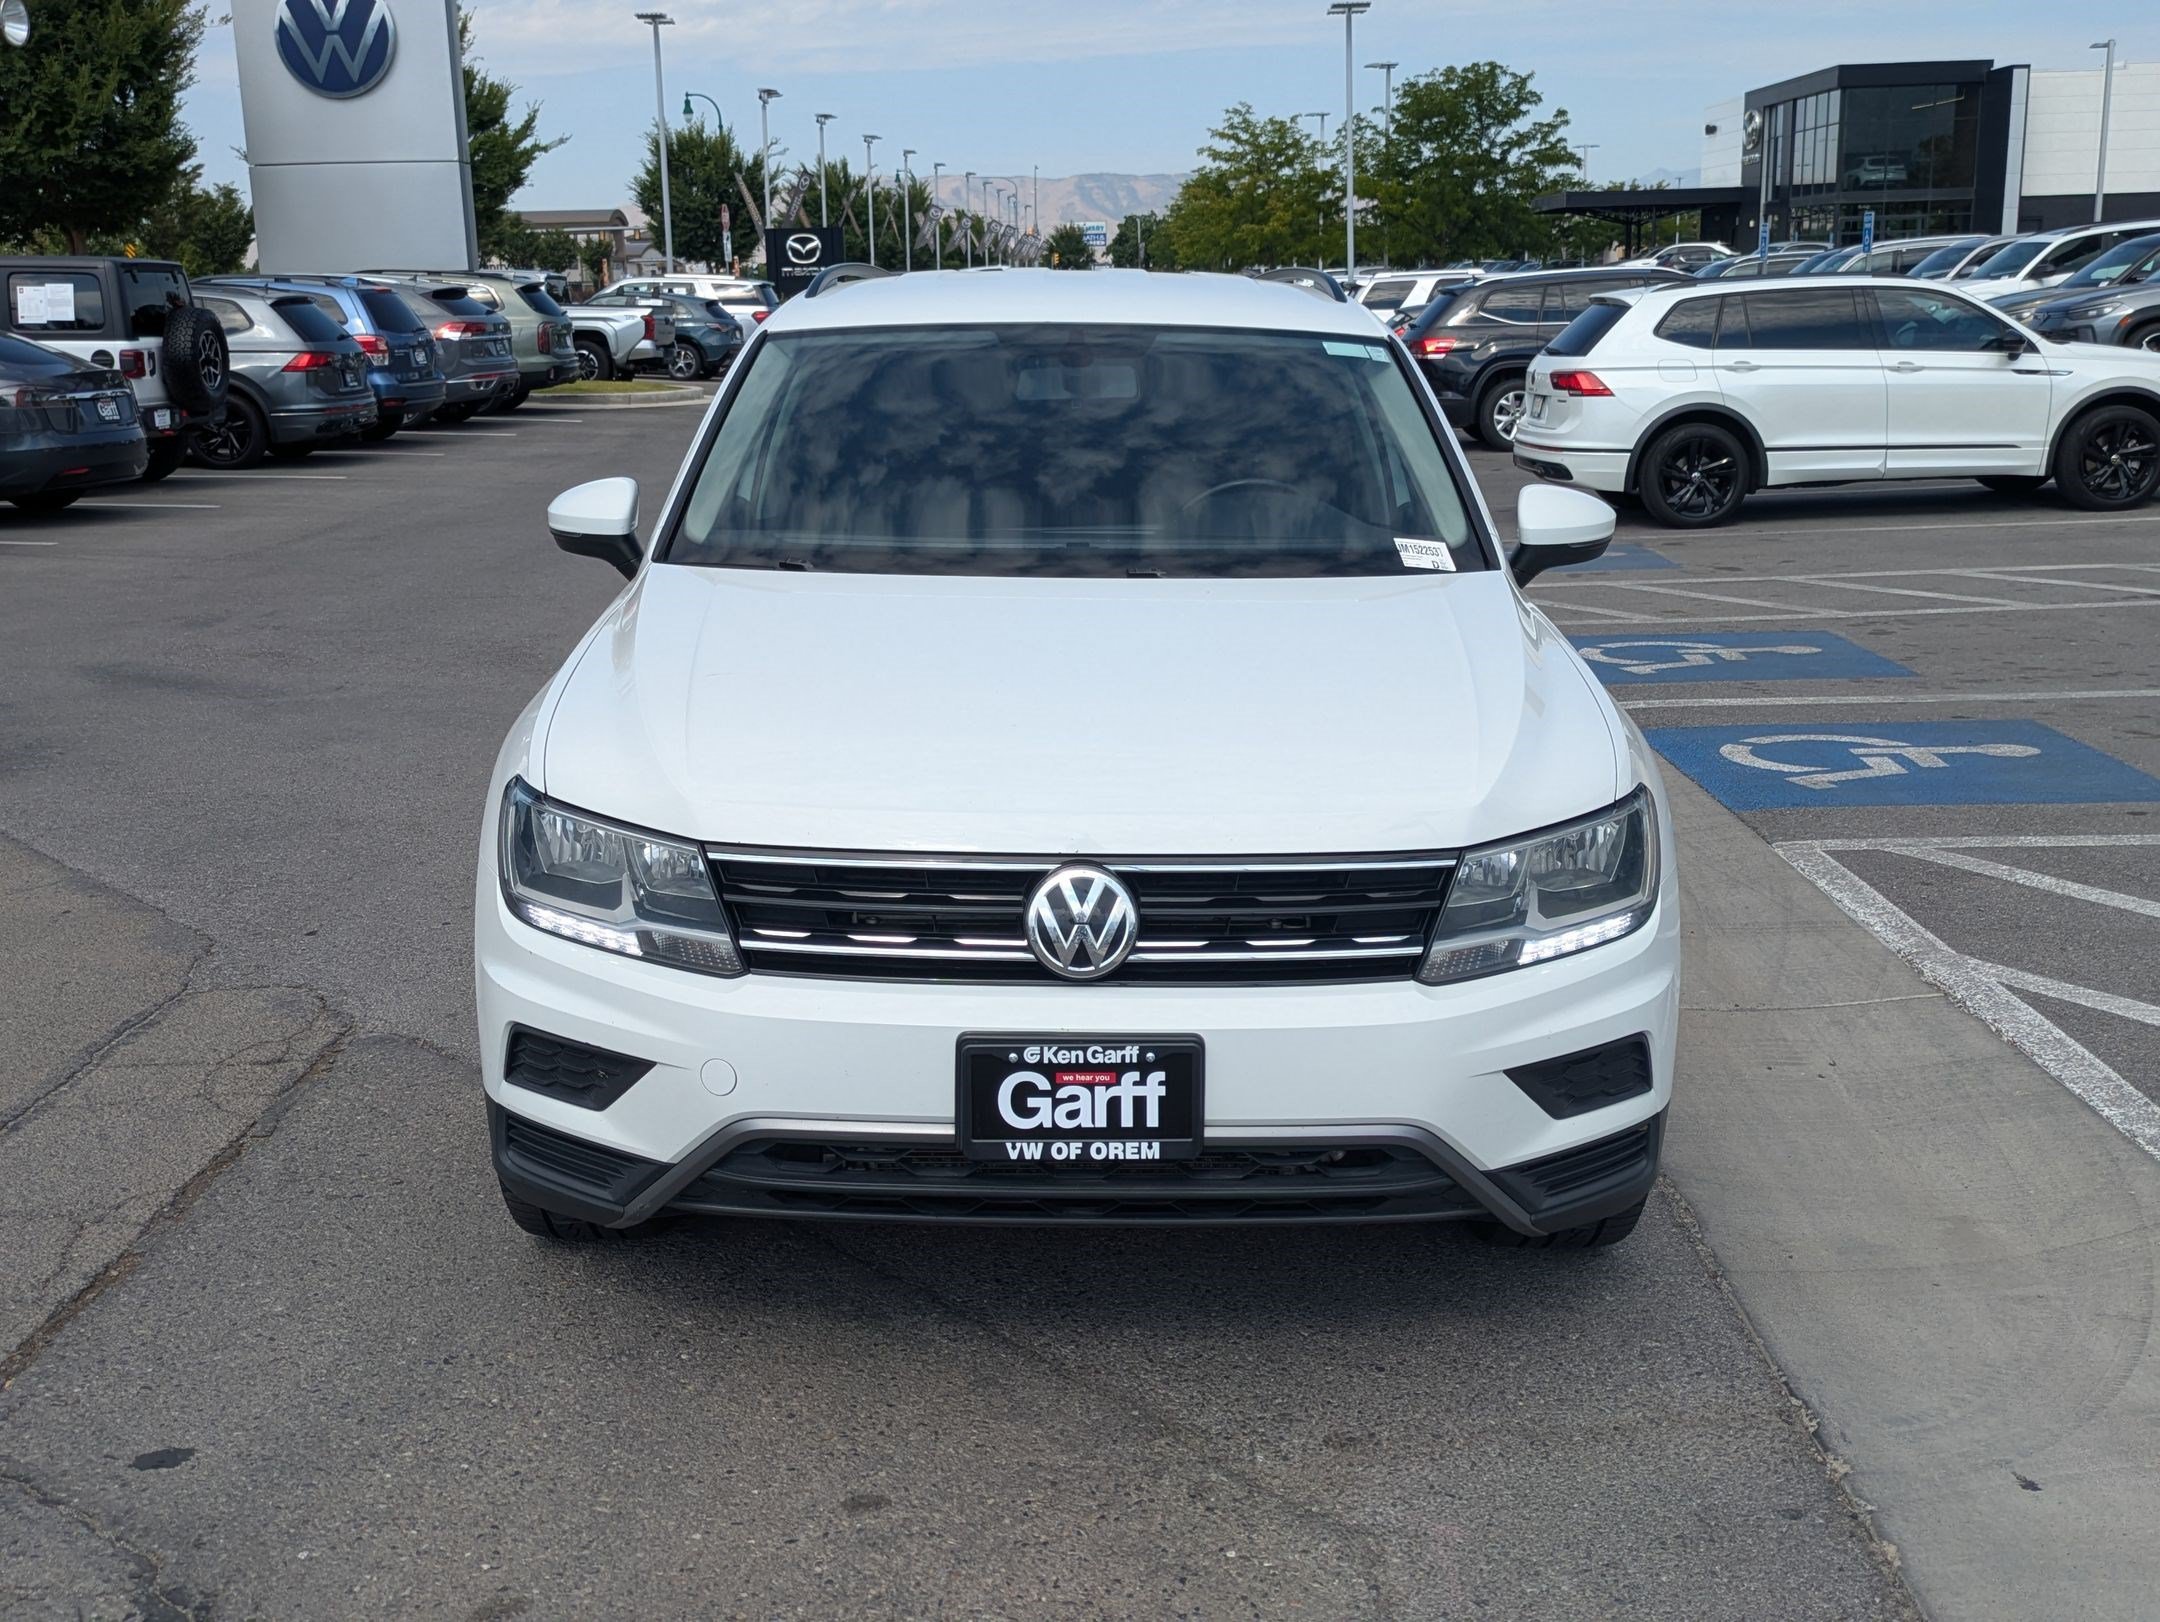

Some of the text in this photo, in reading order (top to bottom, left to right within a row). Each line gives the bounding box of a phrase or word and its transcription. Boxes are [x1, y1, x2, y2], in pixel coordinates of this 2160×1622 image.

[1027, 867, 1137, 977] VW
[1043, 1046, 1139, 1064] Ken Garff
[998, 1071, 1166, 1129] Garff
[1005, 1142, 1160, 1160] VW OF OREM
